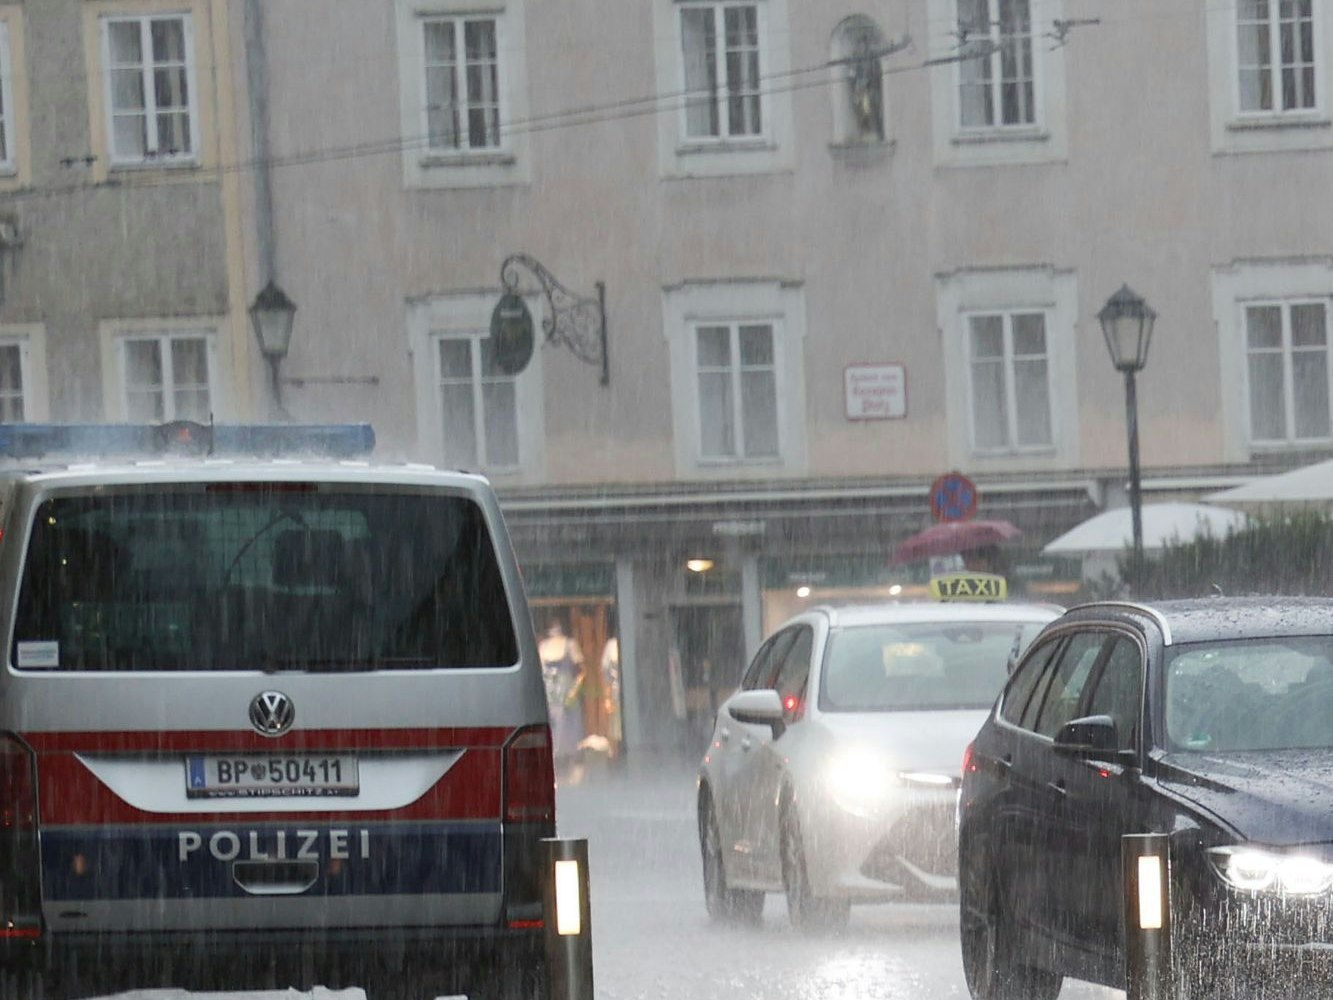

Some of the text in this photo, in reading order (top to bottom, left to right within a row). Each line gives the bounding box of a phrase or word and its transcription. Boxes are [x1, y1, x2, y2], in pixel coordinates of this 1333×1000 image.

[942, 580, 997, 595] TAXI
[217, 759, 342, 783] BP 50411
[178, 829, 370, 862] POLIZEI
